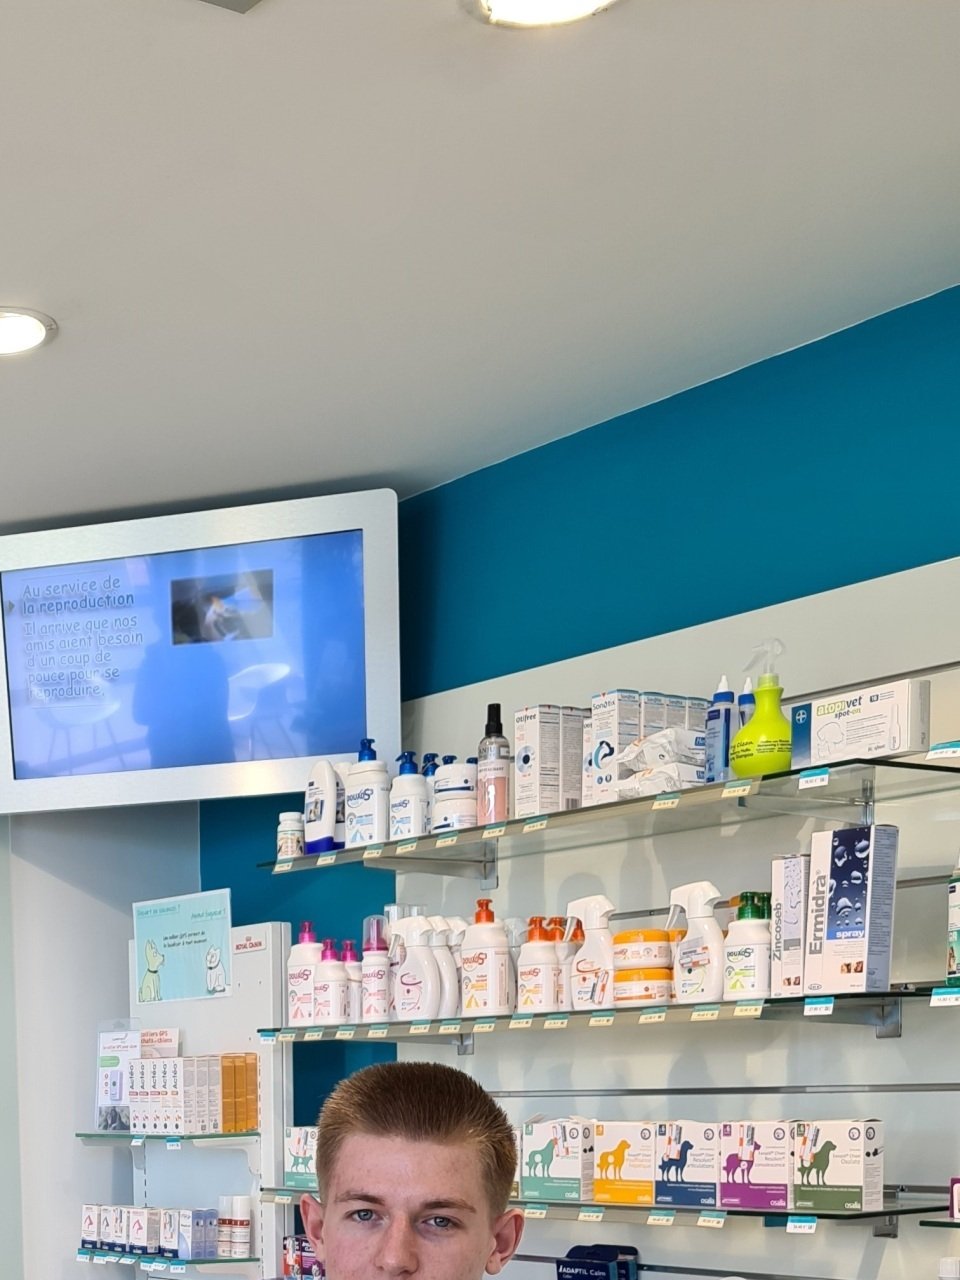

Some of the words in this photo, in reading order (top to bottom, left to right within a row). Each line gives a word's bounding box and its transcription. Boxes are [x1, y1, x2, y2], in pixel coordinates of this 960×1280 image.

[23, 584, 40, 597] Au
[45, 580, 97, 595] service
[103, 575, 120, 590] de
[23, 602, 35, 614] la
[40, 593, 134, 615] reproduction
[24, 622, 36, 635] Il
[40, 622, 80, 634] arrive
[85, 619, 109, 633] que
[114, 616, 137, 627] nos
[26, 640, 55, 652] amis
[59, 636, 92, 649] aient
[98, 632, 143, 646] besoin
[27, 654, 55, 667] d'un
[60, 653, 90, 667] coup
[95, 650, 112, 662] de
[28, 671, 65, 684] pouce
[70, 670, 99, 686] pour
[105, 667, 120, 678] se
[772, 902, 783, 961] Zincoseb
[836, 930, 865, 939] spray
[562, 1266, 588, 1276] ADAPTIL
[589, 1269, 606, 1277] Calm
